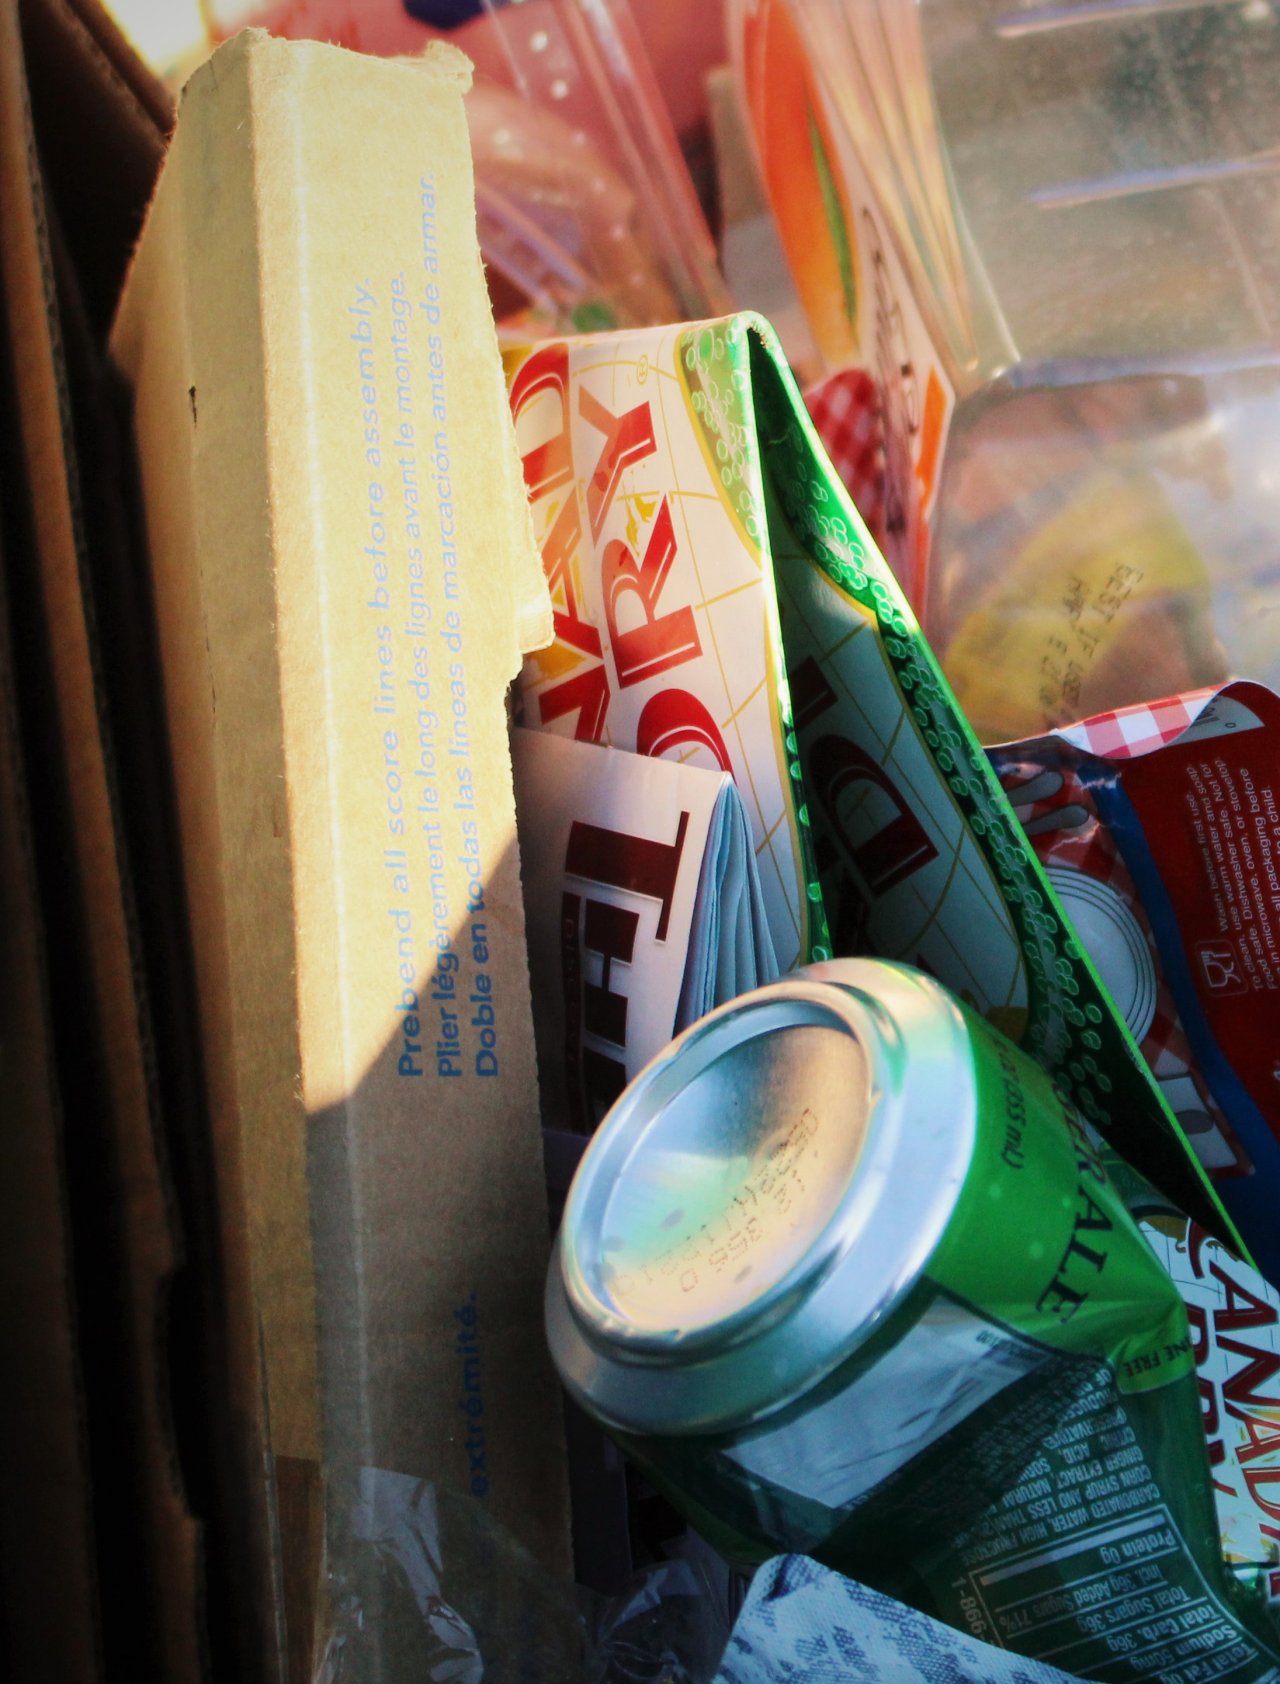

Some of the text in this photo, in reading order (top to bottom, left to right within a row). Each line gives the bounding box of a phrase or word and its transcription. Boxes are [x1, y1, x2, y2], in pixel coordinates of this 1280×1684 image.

[416, 173, 499, 1076] Doble en todas las líneas de marcación antes de armar.
[348, 276, 424, 1077] Prebend all score lines before assembly.
[388, 270, 462, 1076] Plier légèrement le long des lignes avant le montage.
[1214, 756, 1241, 812] stovetop.
[1238, 767, 1260, 814] before
[1200, 796, 1216, 822] and
[1234, 814, 1245, 829] or
[1260, 786, 1280, 823] child.
[1192, 819, 1206, 844] first
[1208, 825, 1226, 863] water
[1200, 846, 1219, 890] before
[1238, 834, 1256, 870] oven,
[1199, 761, 1278, 990] Food safe. Dishwasher safe. Not for
[1218, 866, 1235, 903] warm
[1212, 892, 1230, 931] Wash
[1228, 905, 1242, 931] use
[1248, 874, 1276, 949] microwave,
[1236, 935, 1256, 974] clean,
[1270, 950, 1280, 964] in
[1251, 974, 1264, 990] To
[1034, 1188, 1114, 1326] ALE
[1122, 1351, 1161, 1376] FREE
[1058, 1442, 1091, 1466] ACID,
[1104, 1444, 1143, 1470] GINGER
[1050, 1459, 1102, 1489] EXTRACT,
[1083, 1474, 1119, 1500] SYRUP
[1120, 1463, 1150, 1487] CORN
[1027, 1498, 1056, 1519] LESS
[1058, 1488, 1081, 1508] AND
[1090, 1481, 1160, 1518] CARBONATED
[998, 1508, 1025, 1530] THAN
[1022, 1522, 1047, 1542] HIGH
[1047, 1506, 1089, 1534] WATER,
[1100, 1528, 1174, 1566] Protein 0g
[998, 1564, 1162, 1632] Incl. 36g Added Sugars 71%
[1078, 1584, 1189, 1634] Total Sugars 36g
[1104, 1601, 1218, 1654] Total Carb. 36g
[1129, 1623, 1235, 1672] Sodium 50mg
